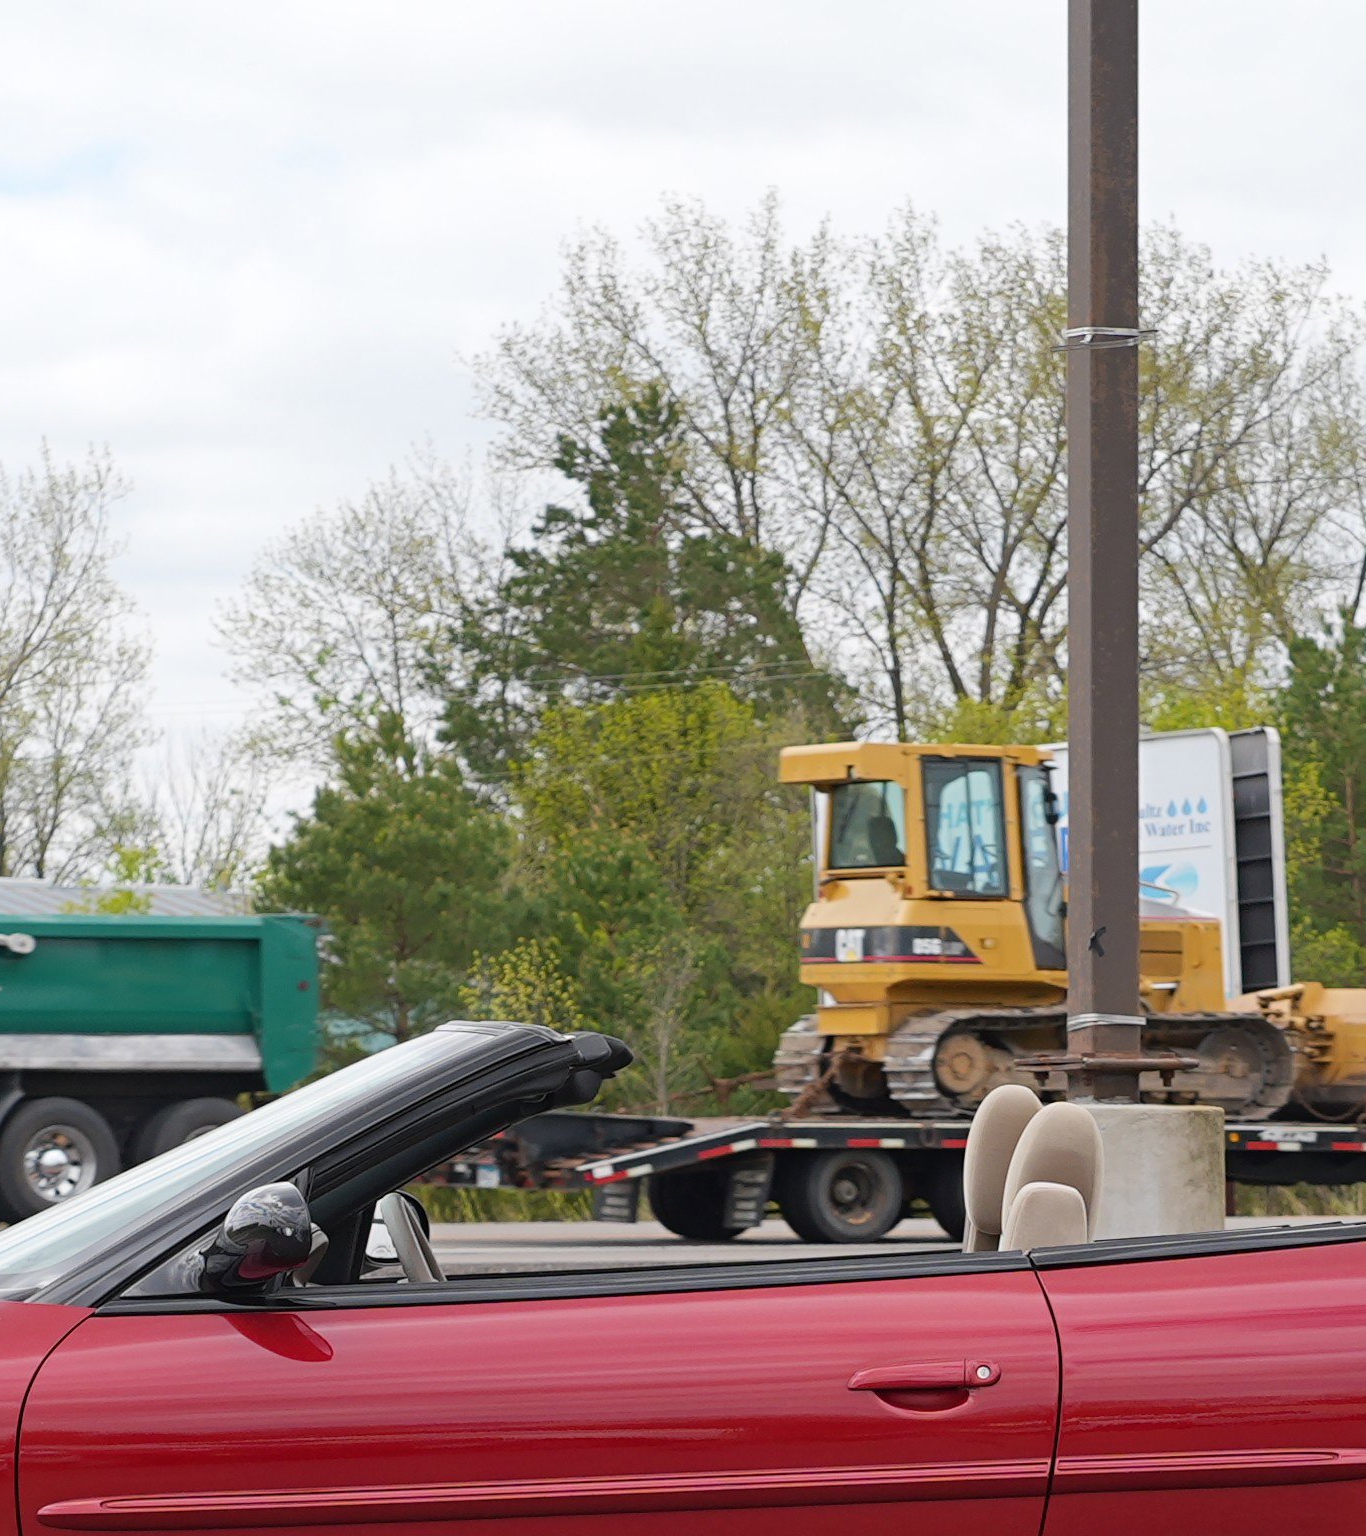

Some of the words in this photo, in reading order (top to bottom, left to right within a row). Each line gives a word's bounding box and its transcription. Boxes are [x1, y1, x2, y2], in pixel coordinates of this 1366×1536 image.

[1145, 822, 1185, 837] Water
[1189, 820, 1211, 834] Inc
[836, 928, 866, 962] CAT
